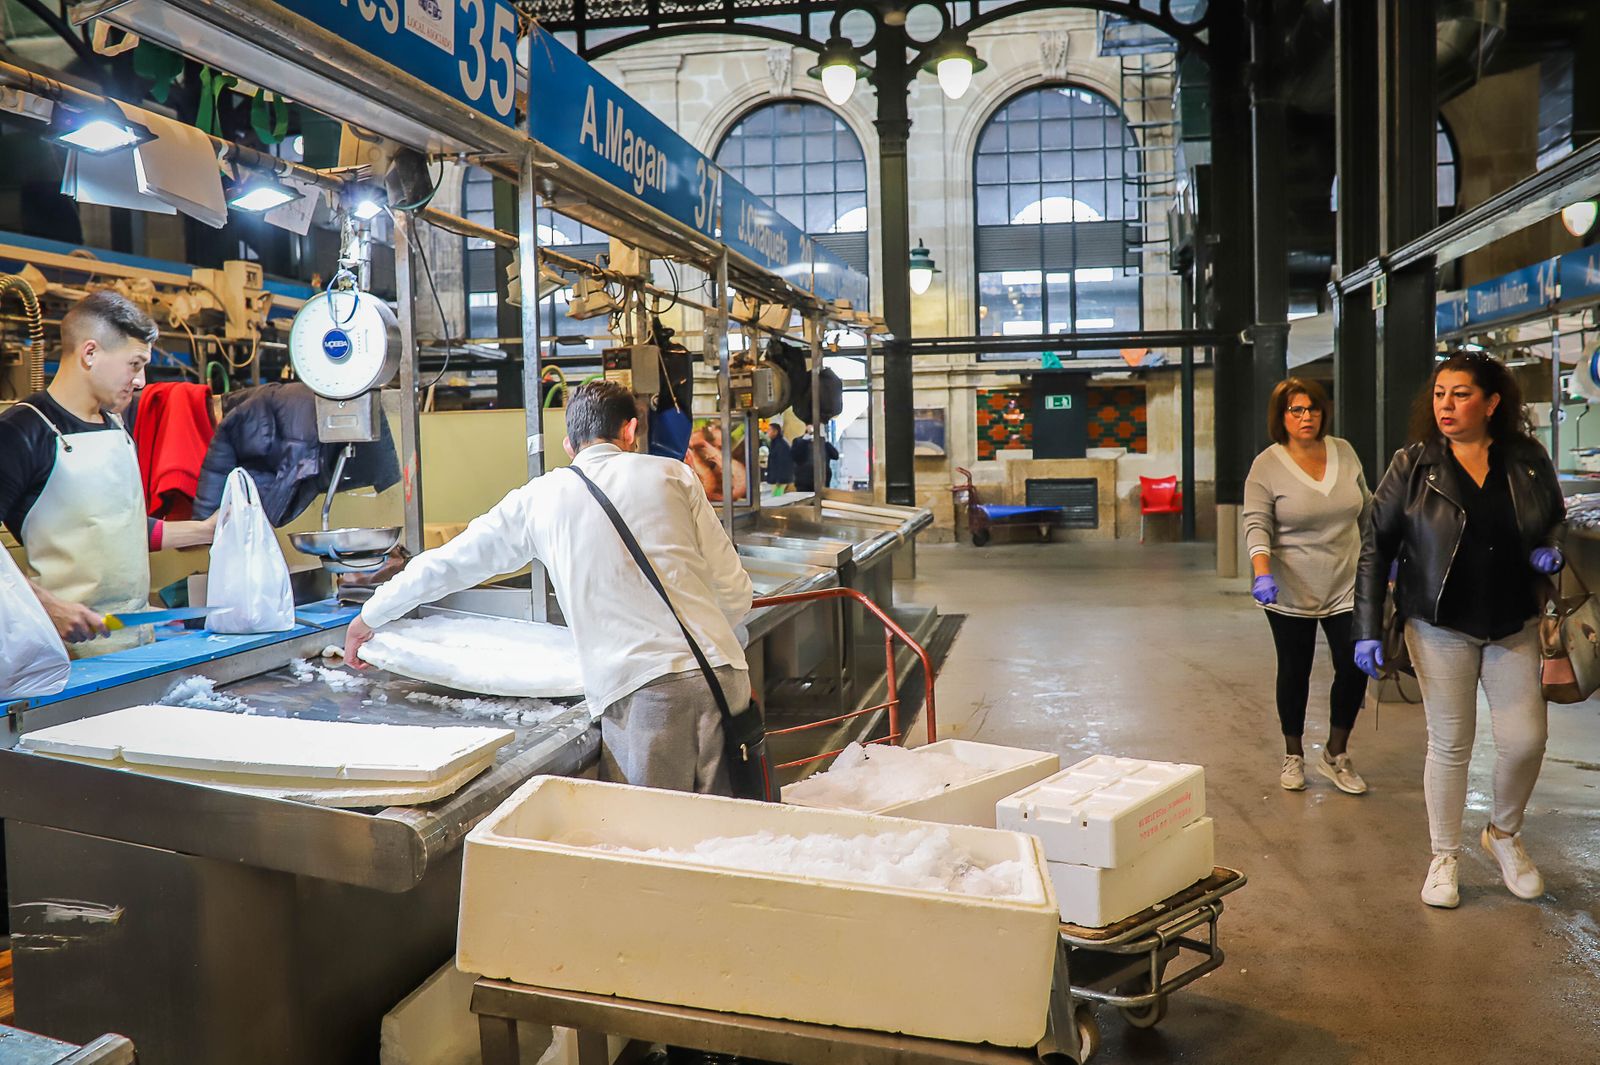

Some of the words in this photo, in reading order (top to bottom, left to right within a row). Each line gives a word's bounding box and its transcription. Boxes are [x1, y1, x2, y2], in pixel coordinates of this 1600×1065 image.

[407, 16, 426, 35] LOCAL
[459, 0, 515, 116] 35
[579, 84, 667, 195] A.Magan
[694, 158, 718, 233] 37
[1537, 261, 1555, 305] 14
